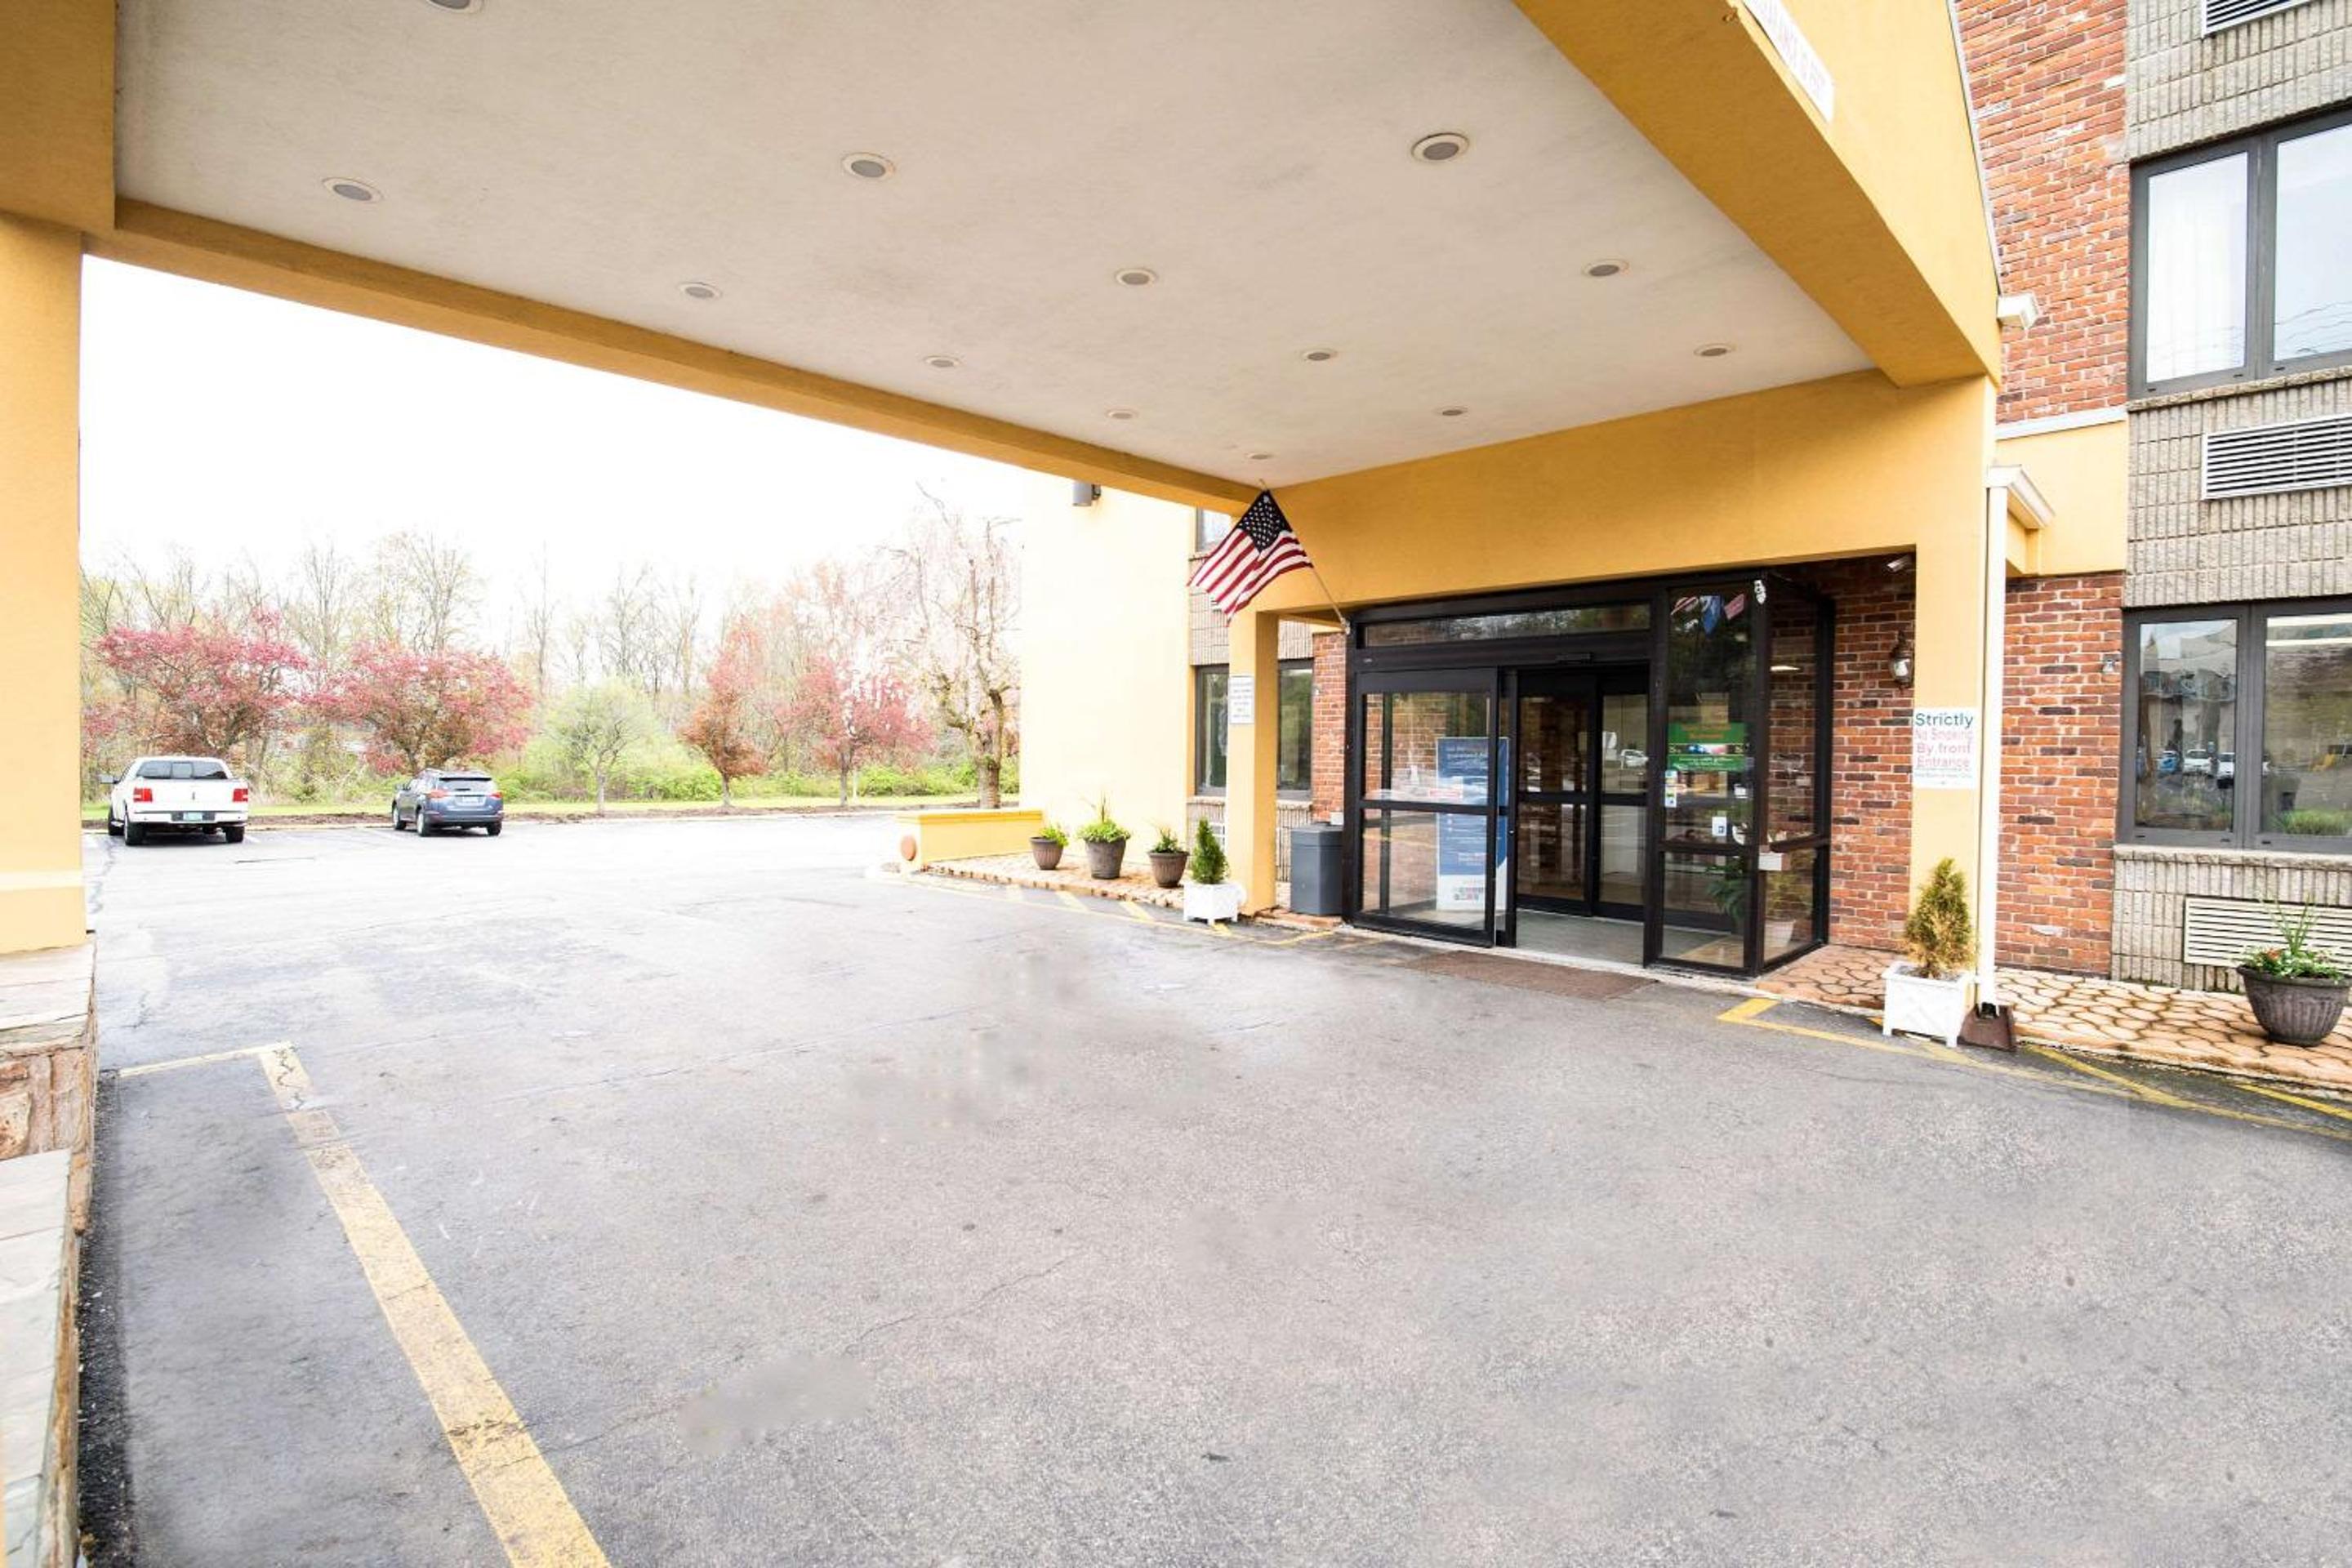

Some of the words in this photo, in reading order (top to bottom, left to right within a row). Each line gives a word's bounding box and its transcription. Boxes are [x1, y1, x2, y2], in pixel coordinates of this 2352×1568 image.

[1915, 713, 1973, 729] Strictly
[1917, 743, 1934, 755] By
[1939, 742, 1970, 753] front
[1917, 755, 1969, 767] Entrance
